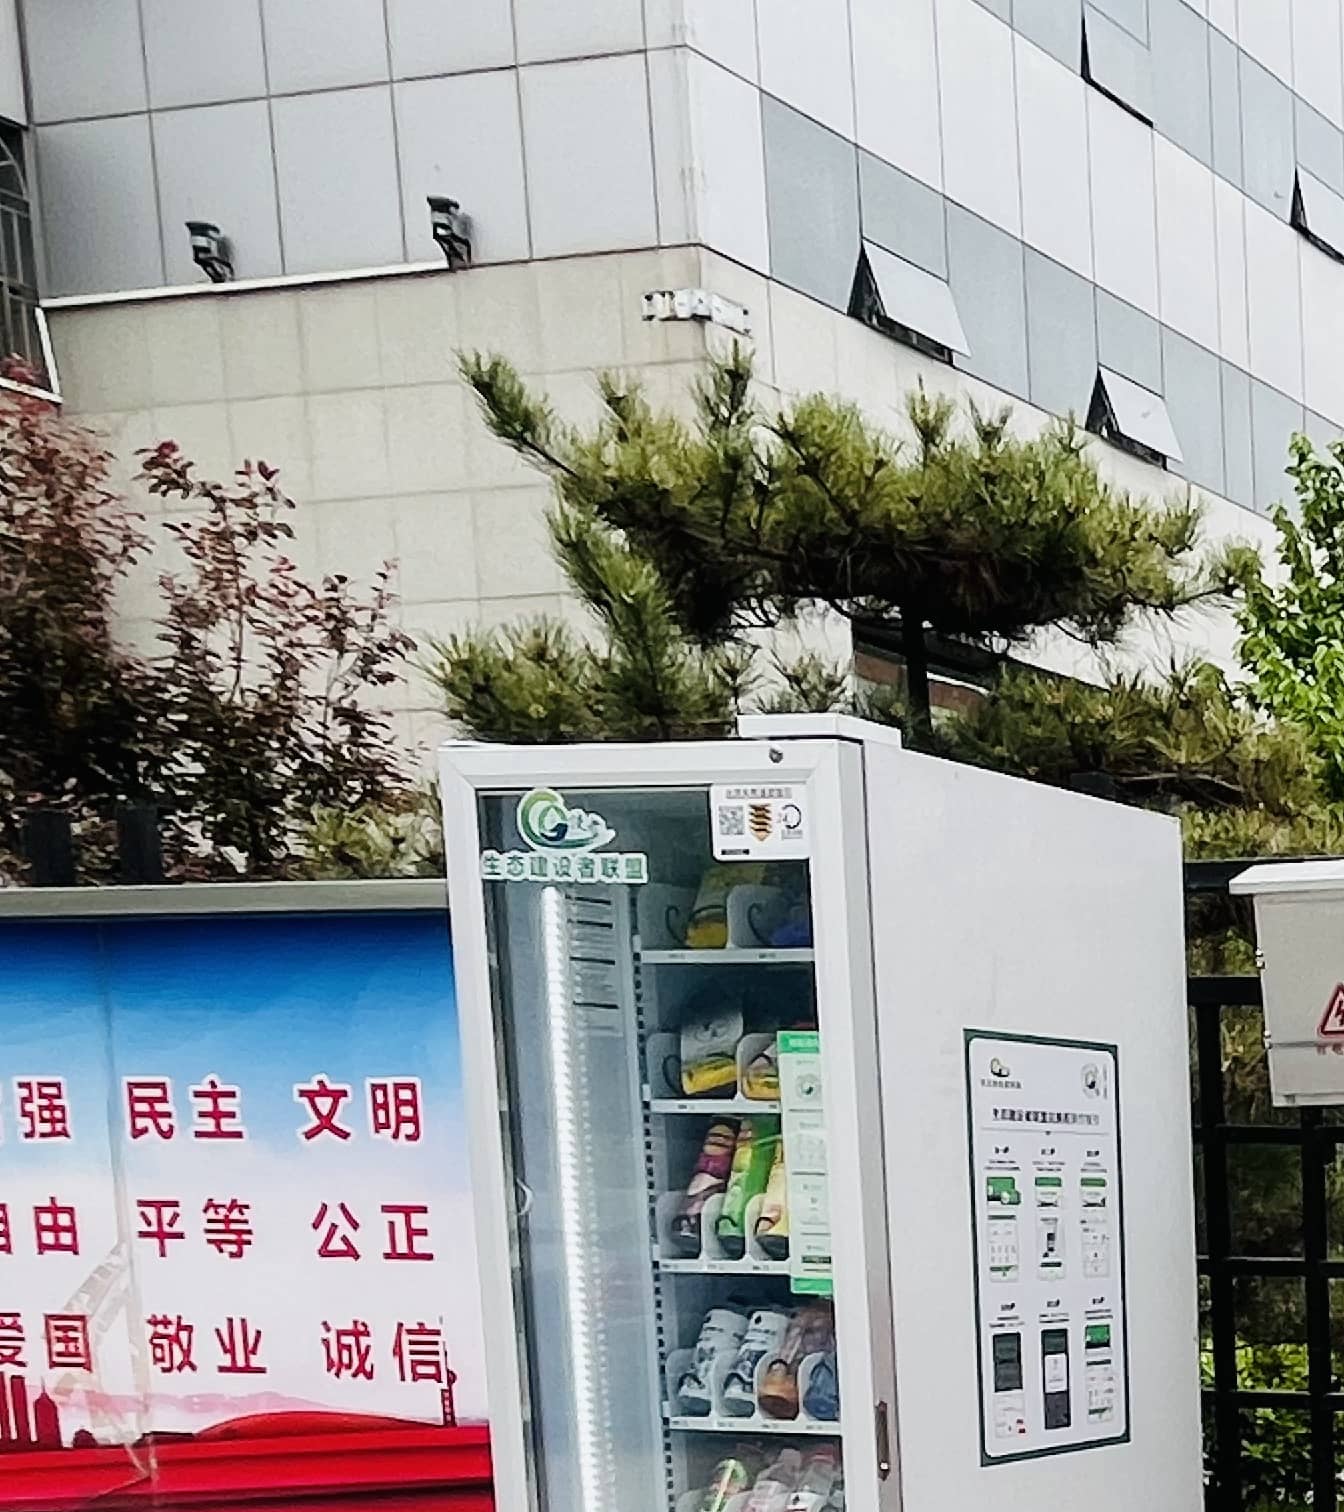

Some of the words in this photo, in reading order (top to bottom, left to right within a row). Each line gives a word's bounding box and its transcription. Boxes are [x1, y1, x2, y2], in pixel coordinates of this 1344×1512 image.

[483, 854, 645, 880] 生态建设者联盟
[126, 1080, 244, 1140] 民主
[299, 1080, 422, 1142] 文明
[136, 1199, 254, 1259] 平等
[311, 1202, 434, 1261] 公正
[146, 1314, 267, 1374] 敬业
[321, 1320, 444, 1384] 诚信
